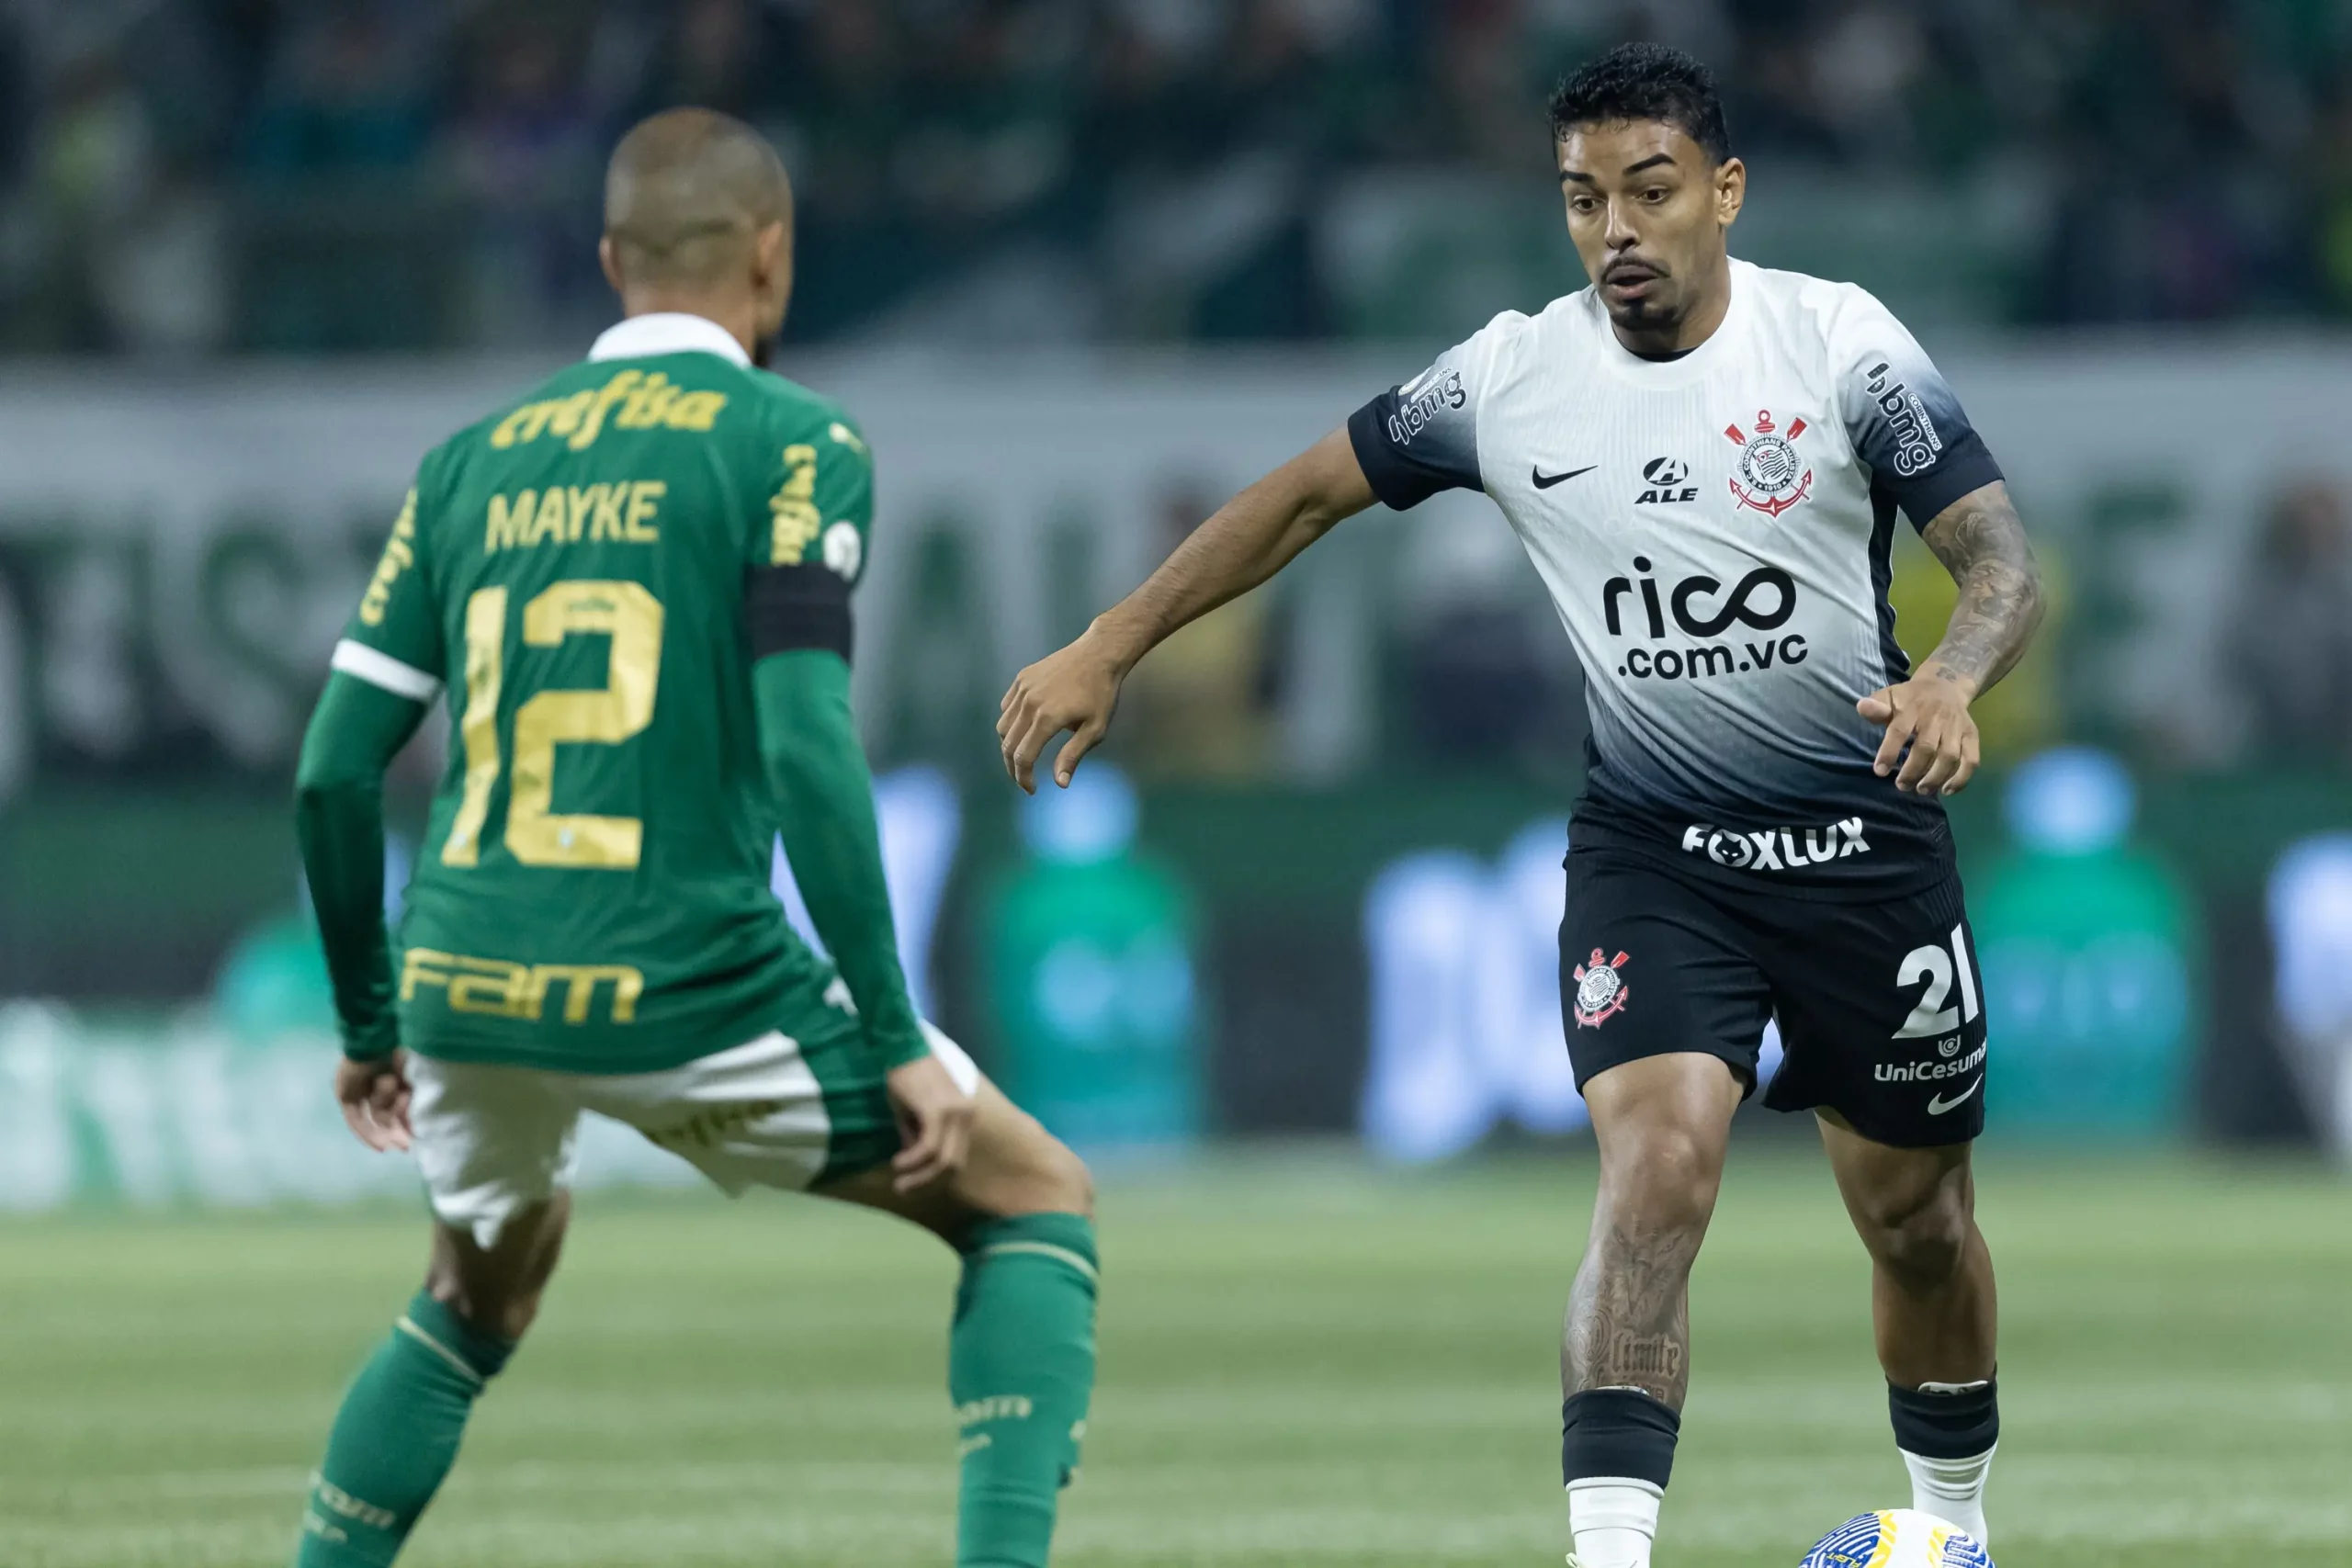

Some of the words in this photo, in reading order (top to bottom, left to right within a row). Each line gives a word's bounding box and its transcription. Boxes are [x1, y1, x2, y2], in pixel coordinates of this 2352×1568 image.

[491, 369, 728, 450] crefisa
[1400, 371, 1467, 435] bmg
[1876, 382, 1937, 476] bmg
[1908, 393, 1942, 451] CORINTHIANS
[1743, 438, 1781, 471] CORINTHIANS
[1781, 445, 1796, 480] PAULISTA
[1763, 483, 1782, 491] 1910
[484, 479, 668, 555] MAYKE
[1634, 487, 1699, 505] ALE
[1602, 555, 1797, 639] rico
[1617, 633, 1808, 681] .com.vc
[441, 579, 664, 869] 12
[1682, 817, 1871, 871] FOXLUX
[1891, 922, 1979, 1040] 21
[1874, 1035, 1987, 1082] UniCesuma
